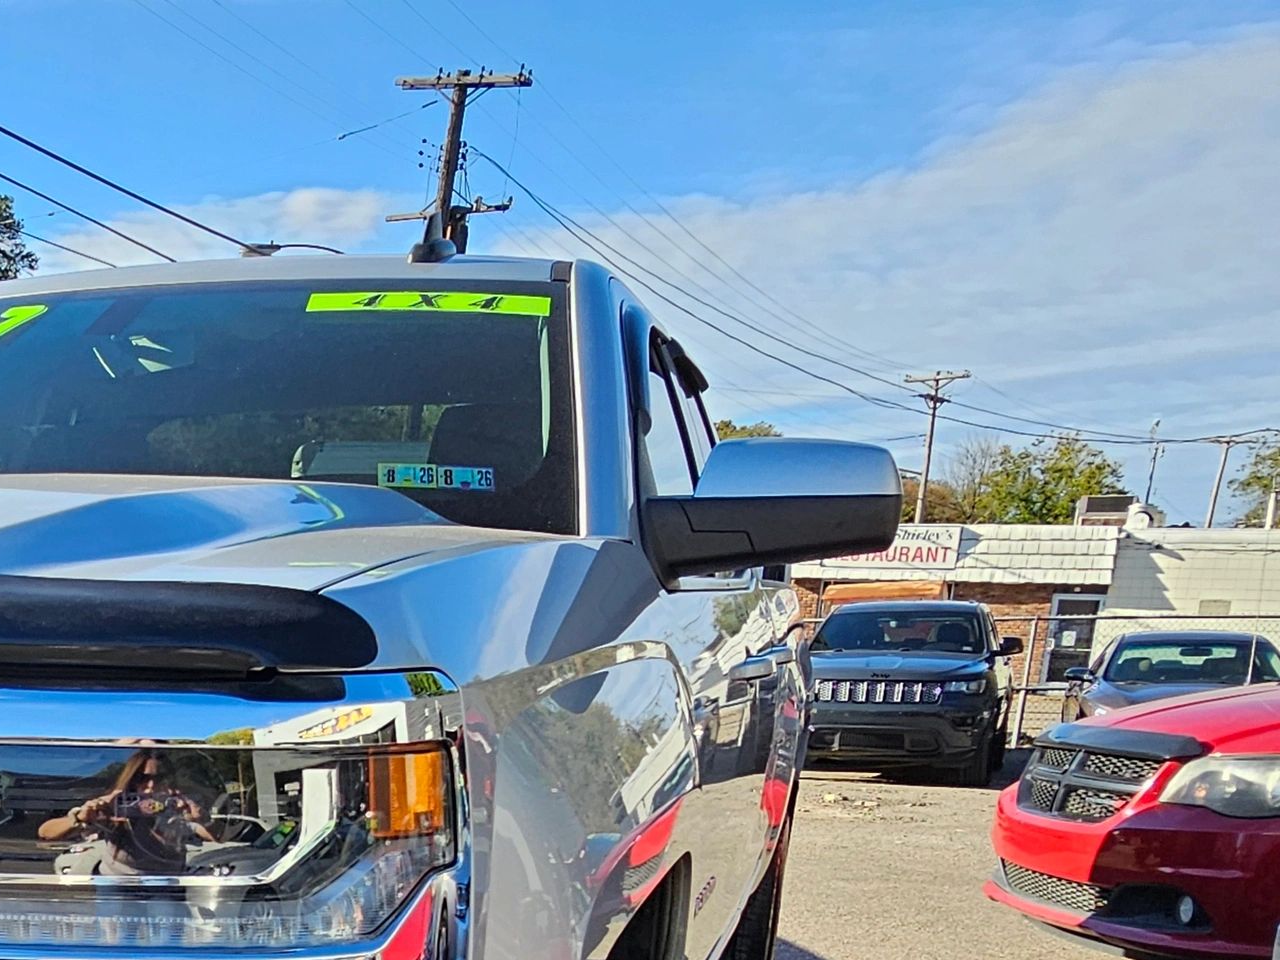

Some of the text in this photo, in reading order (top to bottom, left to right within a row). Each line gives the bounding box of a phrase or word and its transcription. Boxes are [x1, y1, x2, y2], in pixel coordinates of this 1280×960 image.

[386, 467, 434, 484] 8 26
[443, 469, 492, 487] 8 26
